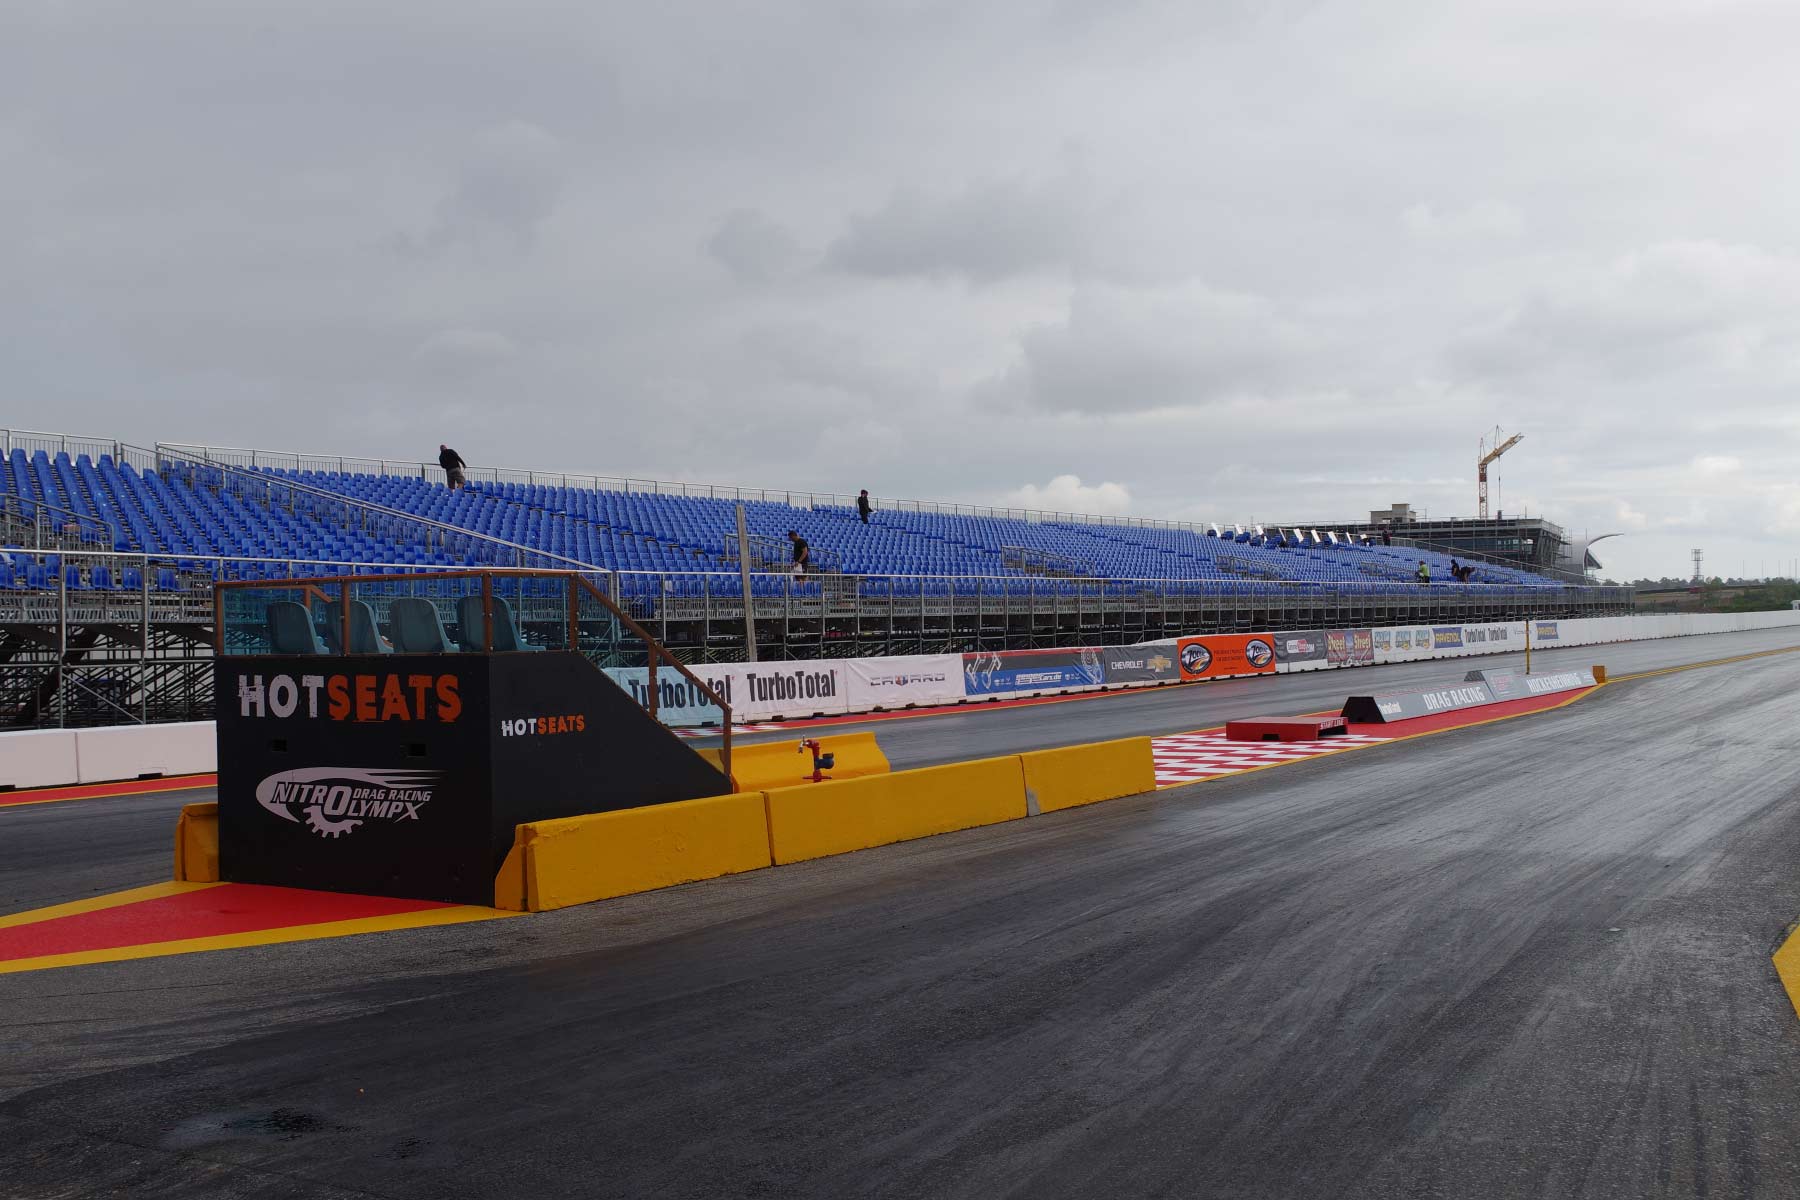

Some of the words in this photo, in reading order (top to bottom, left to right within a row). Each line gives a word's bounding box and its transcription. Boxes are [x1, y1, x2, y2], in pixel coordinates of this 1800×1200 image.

[1111, 660, 1143, 670] CHEVROLET
[747, 669, 836, 702] TurboTotal
[238, 674, 463, 722] HOTSEATS
[1423, 691, 1451, 710] DRAG
[1450, 686, 1486, 706] RACING
[501, 715, 585, 737] HOTSEATS
[353, 788, 386, 800] DRAG
[389, 790, 432, 802] RACING
